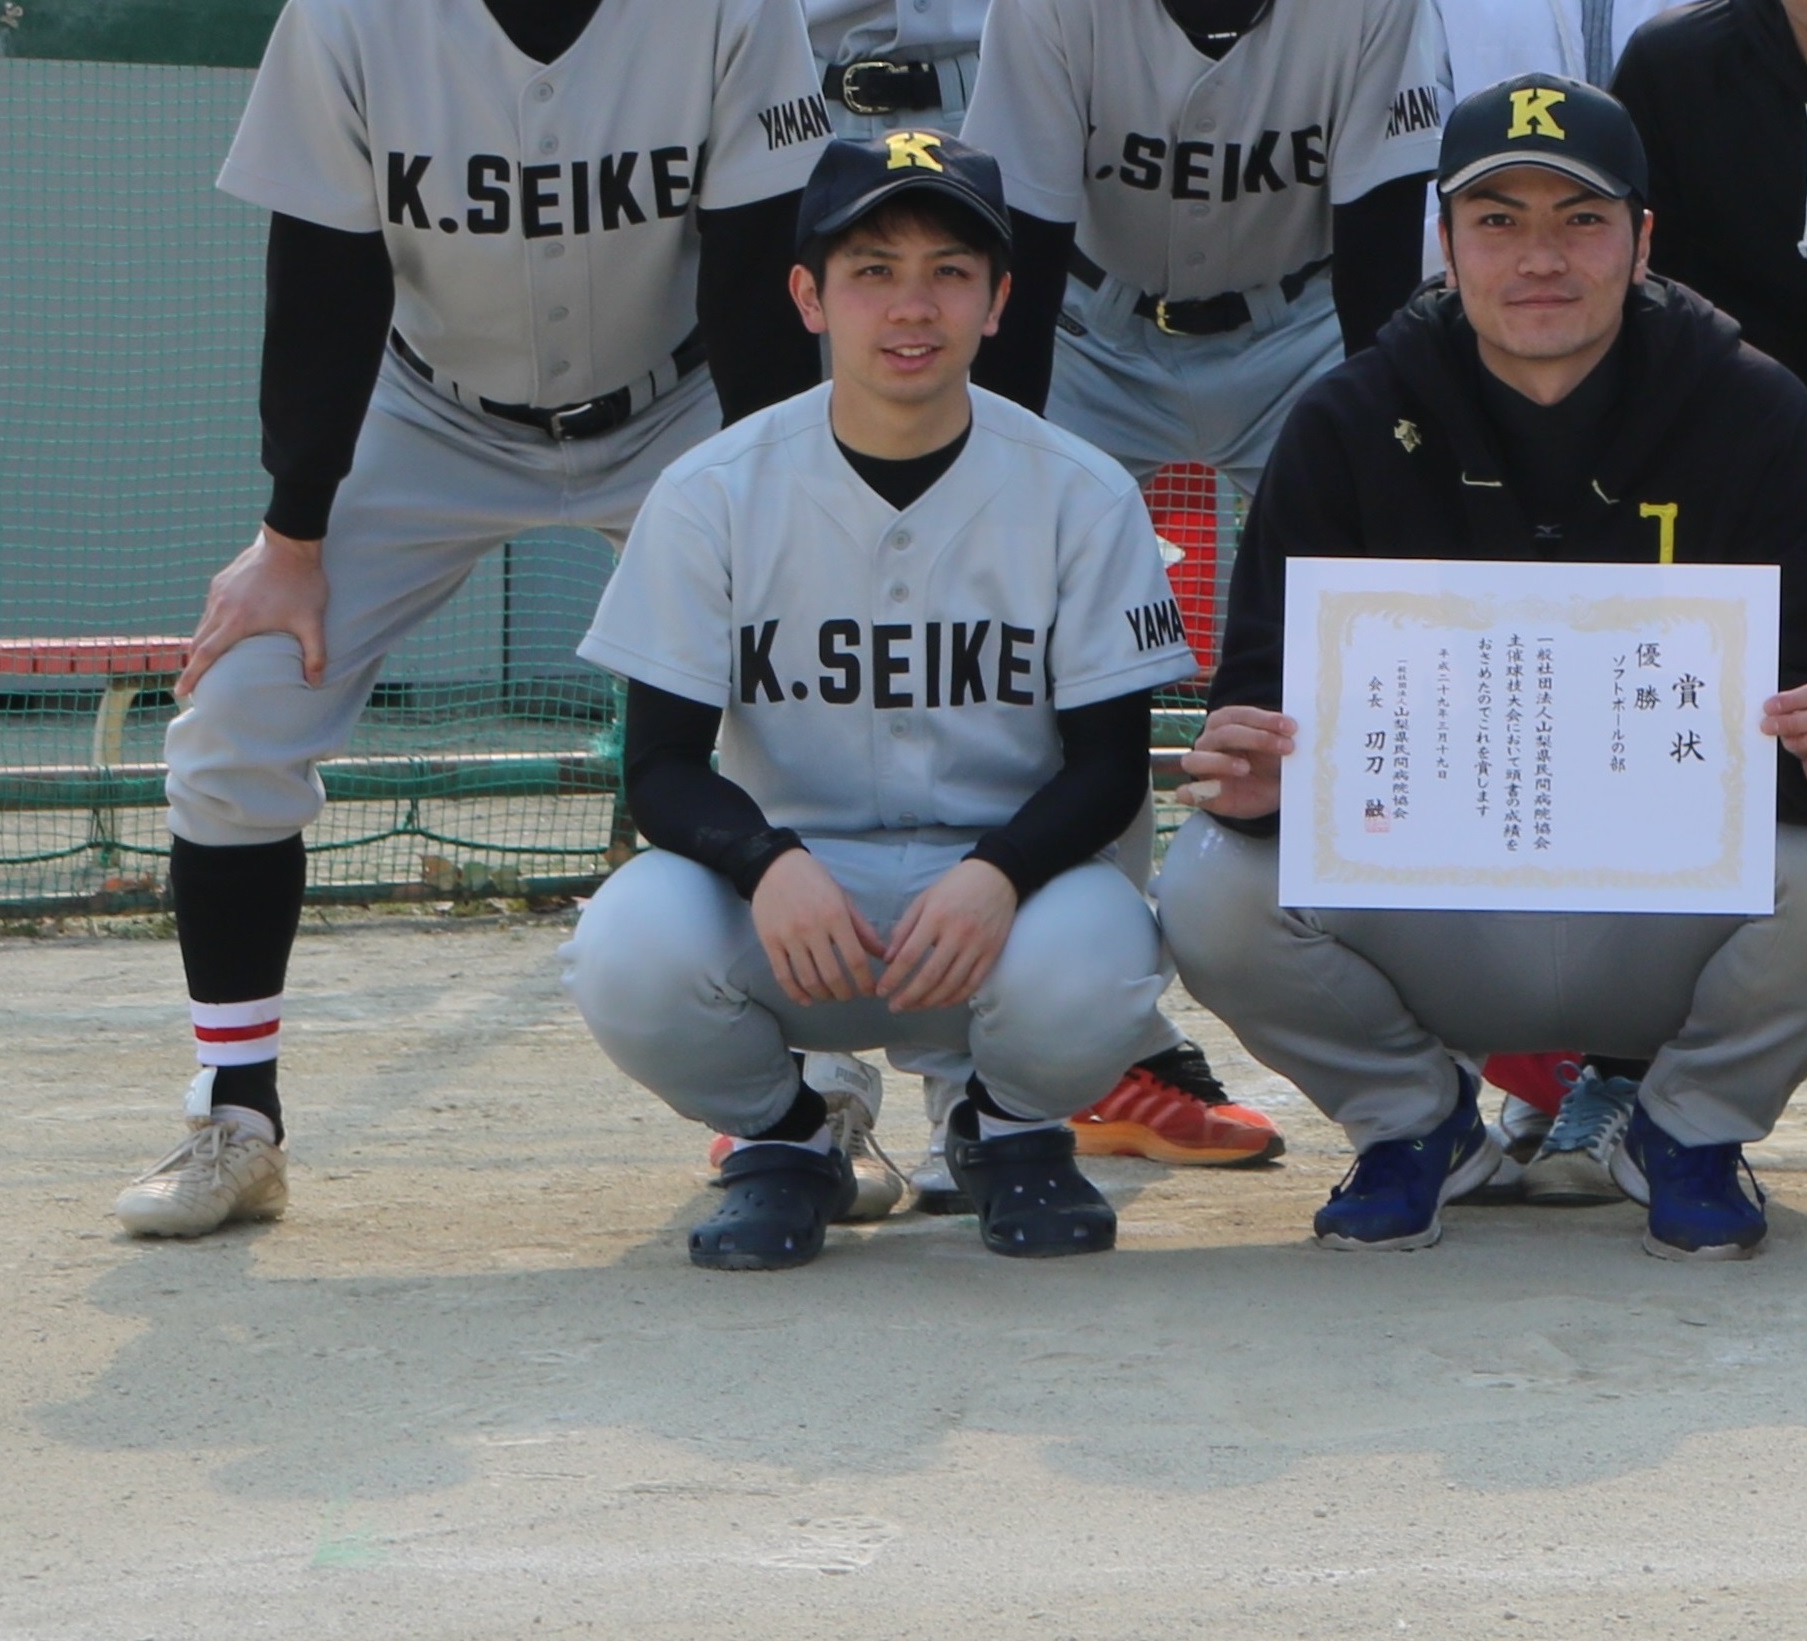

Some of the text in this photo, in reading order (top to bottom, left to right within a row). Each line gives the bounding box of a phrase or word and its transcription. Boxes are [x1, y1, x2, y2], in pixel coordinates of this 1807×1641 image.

[1507, 88, 1565, 140] K
[886, 132, 943, 172] K
[1634, 642, 1661, 711] 優勝
[1609, 654, 1626, 773] ソフトボールの部
[1669, 672, 1706, 764] 賞状
